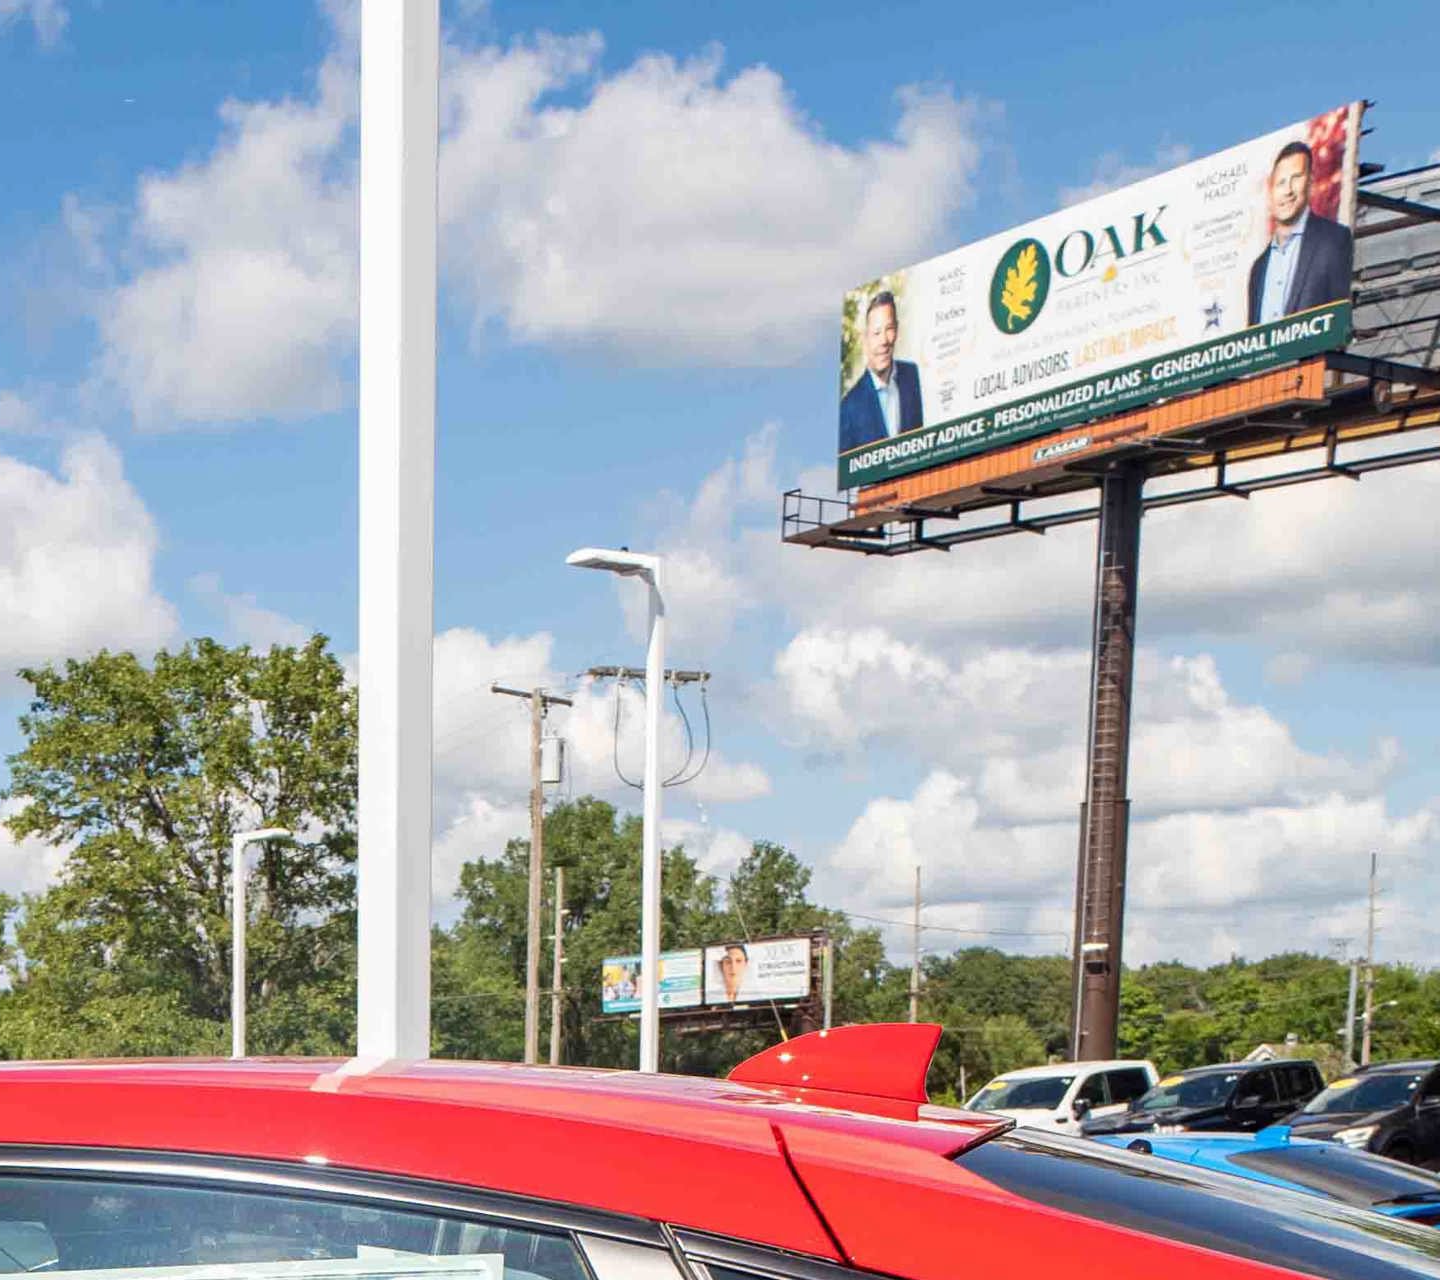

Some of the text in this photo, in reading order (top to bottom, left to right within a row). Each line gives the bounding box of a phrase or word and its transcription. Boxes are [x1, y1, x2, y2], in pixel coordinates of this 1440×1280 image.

[1055, 205, 1168, 278] OAK
[848, 433, 937, 474] INDEPENDENT
[936, 417, 986, 447] ADVICE
[993, 384, 1094, 429] PERSONALIZED
[1095, 370, 1143, 398] PLANS
[1150, 333, 1269, 381] GENERATIONAL
[1270, 312, 1335, 344] IMPACT
[972, 365, 1008, 400] LOCAL
